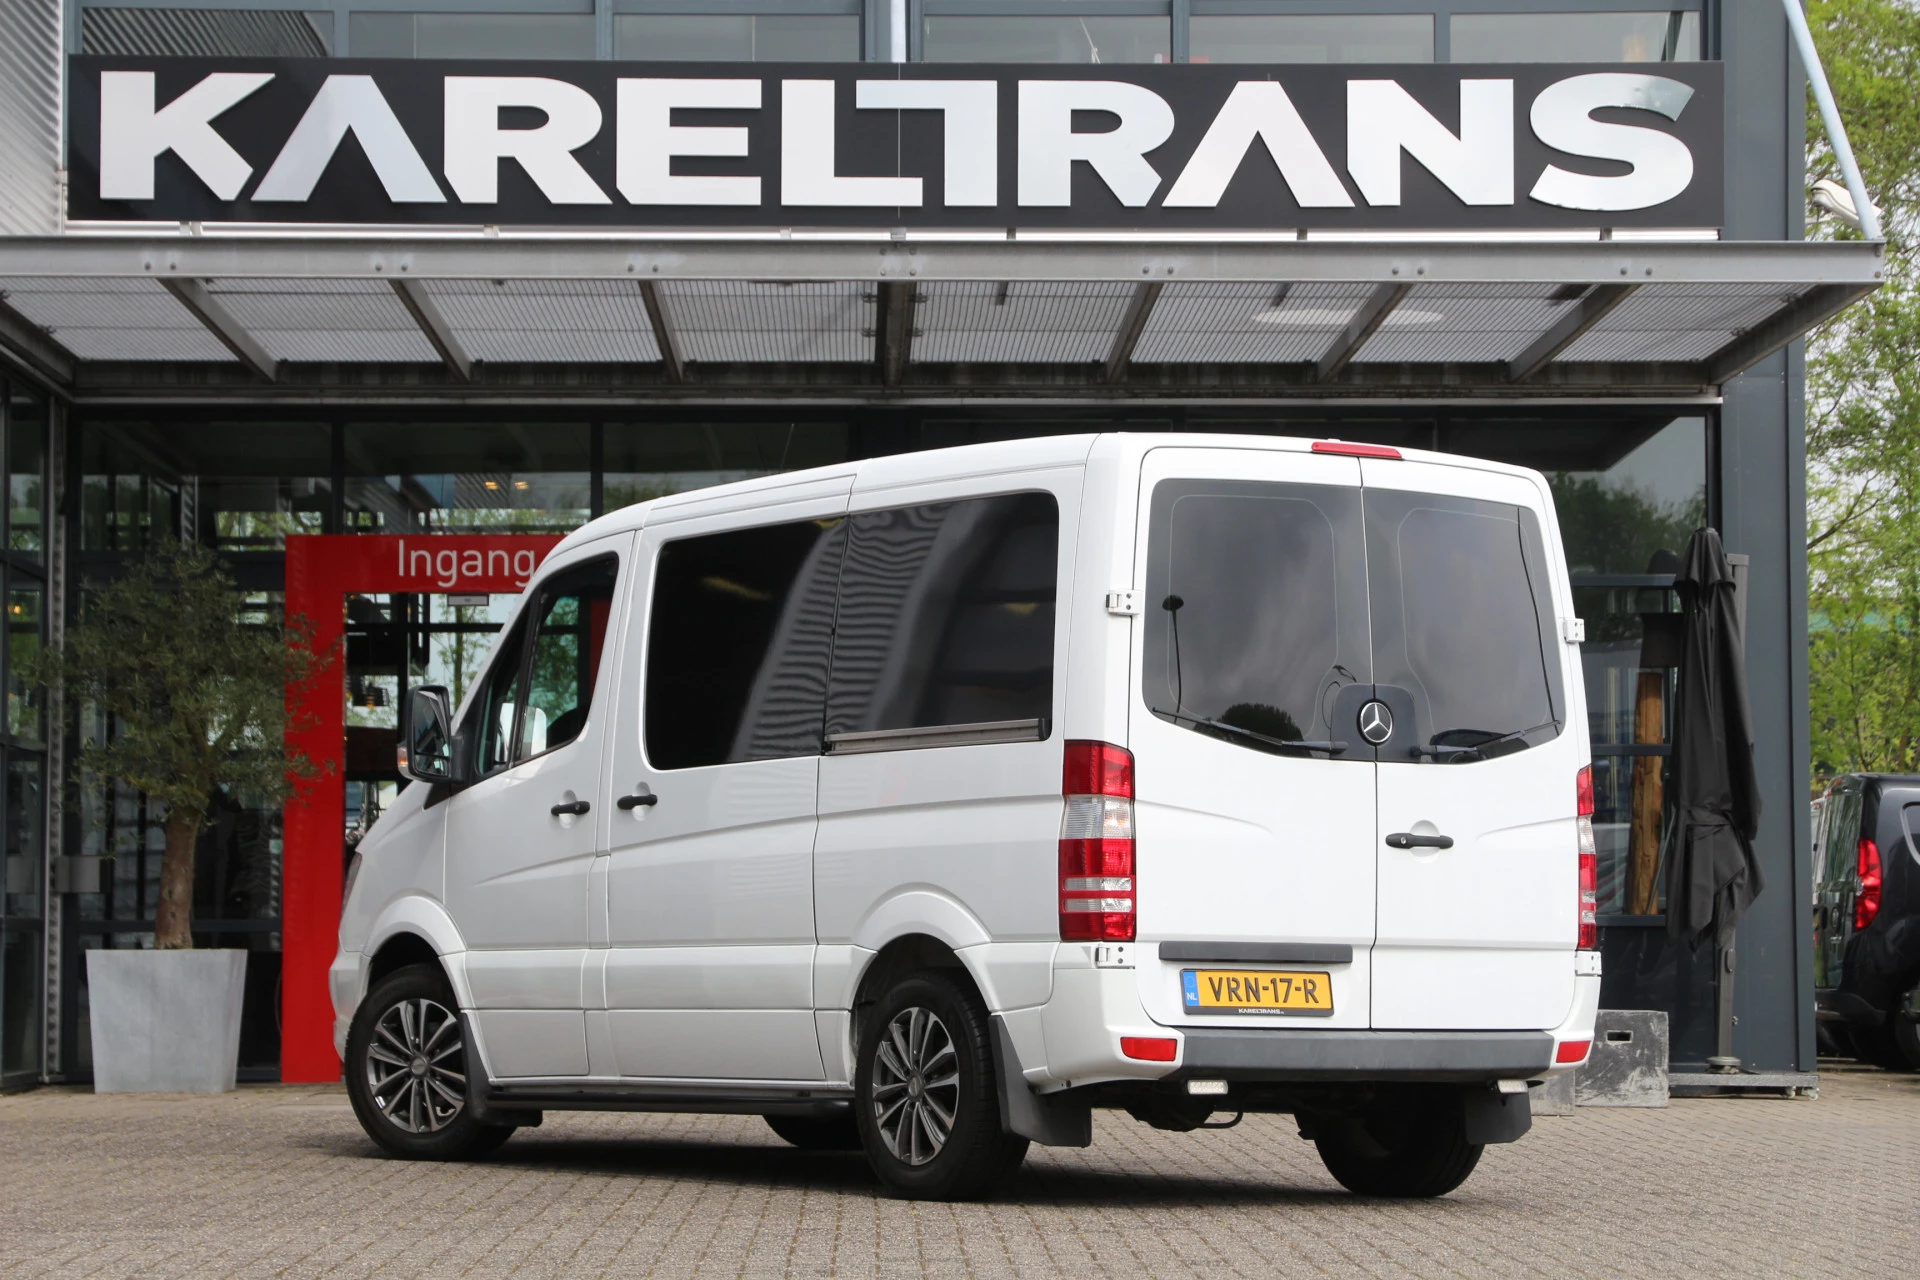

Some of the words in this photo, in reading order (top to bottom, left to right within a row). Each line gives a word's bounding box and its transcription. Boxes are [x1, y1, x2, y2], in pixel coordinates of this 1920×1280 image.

[99, 70, 1696, 211] KARELTRANS
[399, 539, 535, 588] Ingang
[1186, 992, 1197, 1001] NL
[1208, 976, 1319, 1003] VRN-17-R
